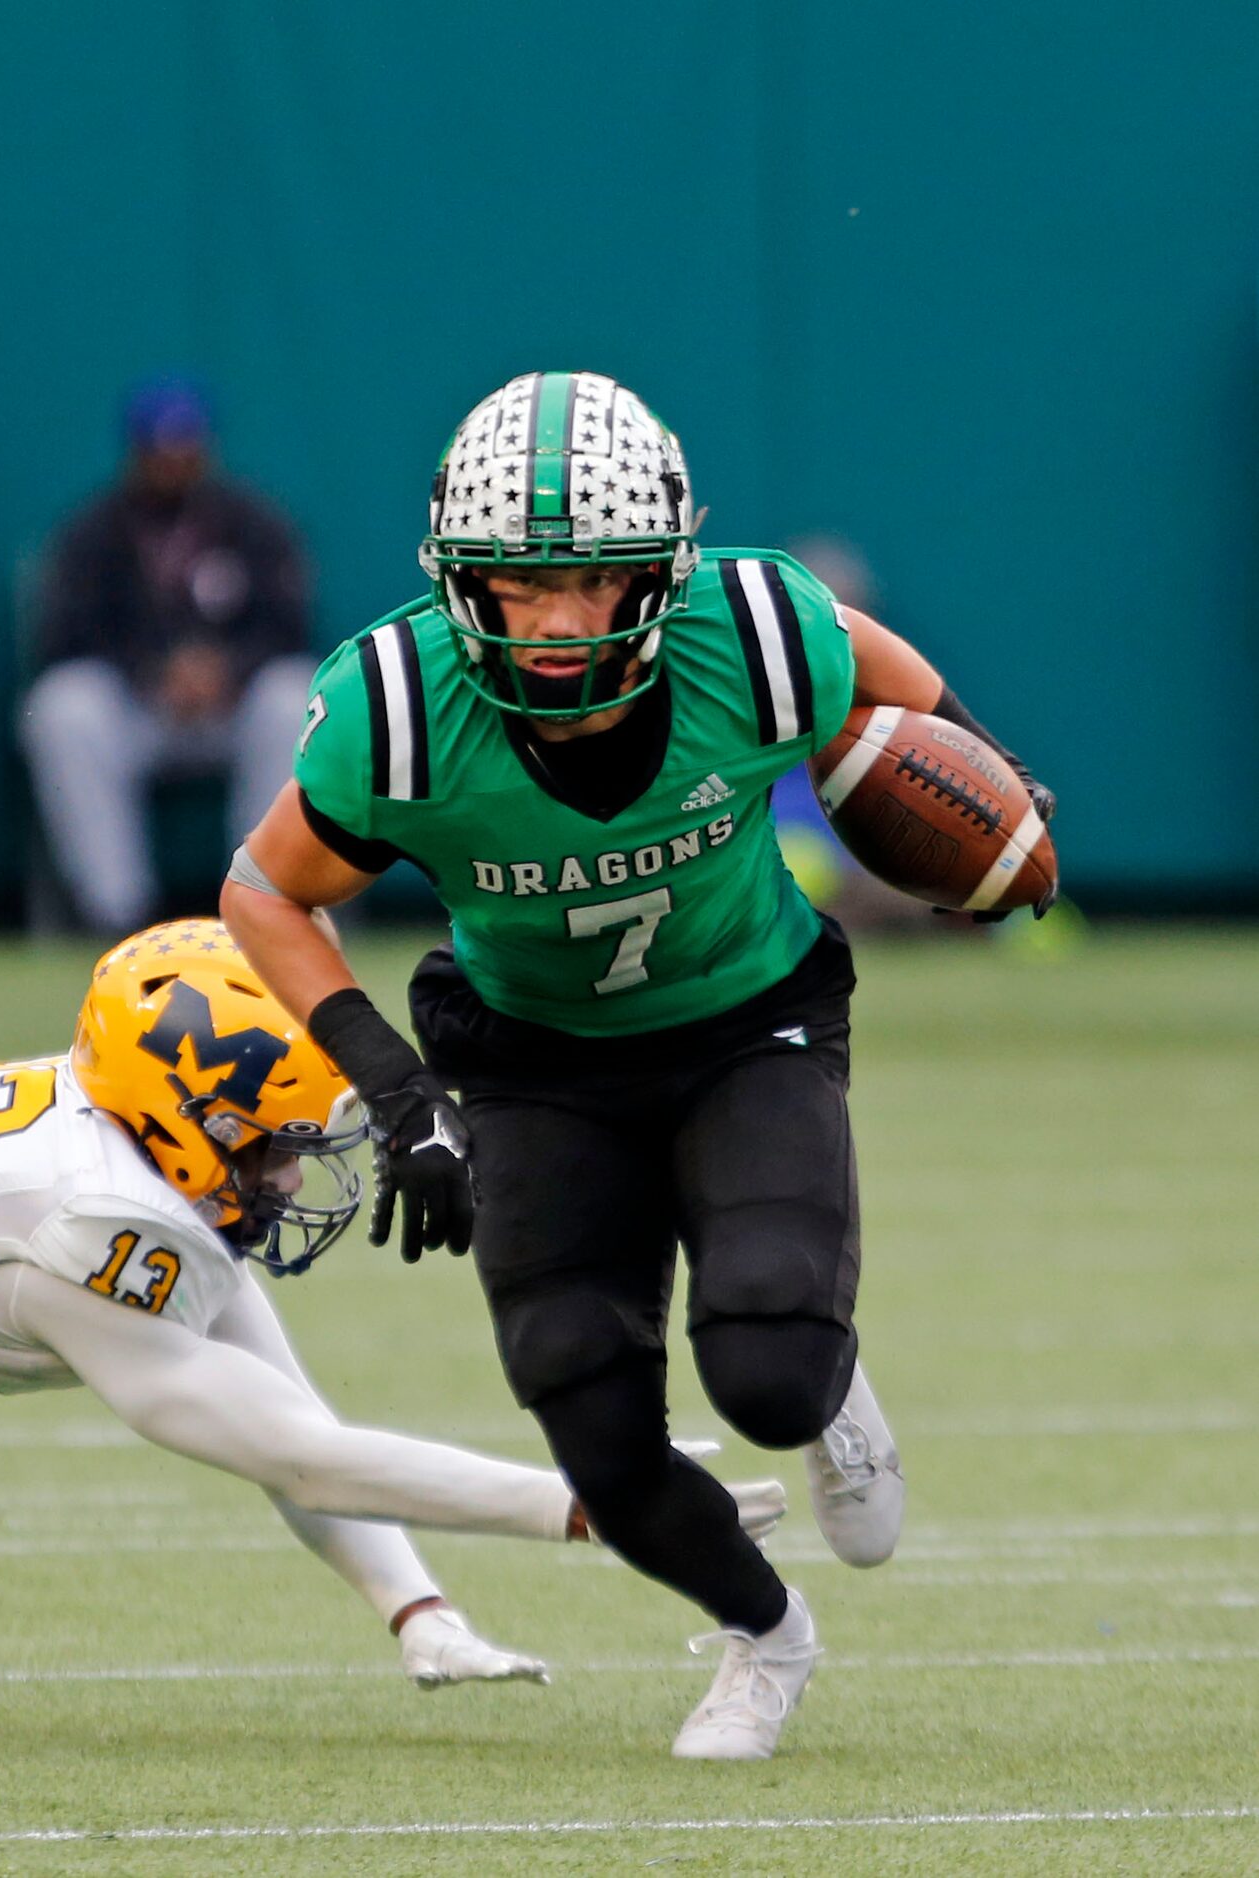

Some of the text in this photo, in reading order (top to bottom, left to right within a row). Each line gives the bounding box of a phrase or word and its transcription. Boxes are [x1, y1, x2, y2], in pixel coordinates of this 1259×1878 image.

[301, 691, 328, 757] 7
[931, 730, 1008, 797] Wilson
[681, 789, 736, 811] adidas
[471, 812, 734, 896] DRAGONS
[565, 886, 672, 995] 7
[136, 979, 291, 1116] M
[84, 1229, 181, 1315] 13
